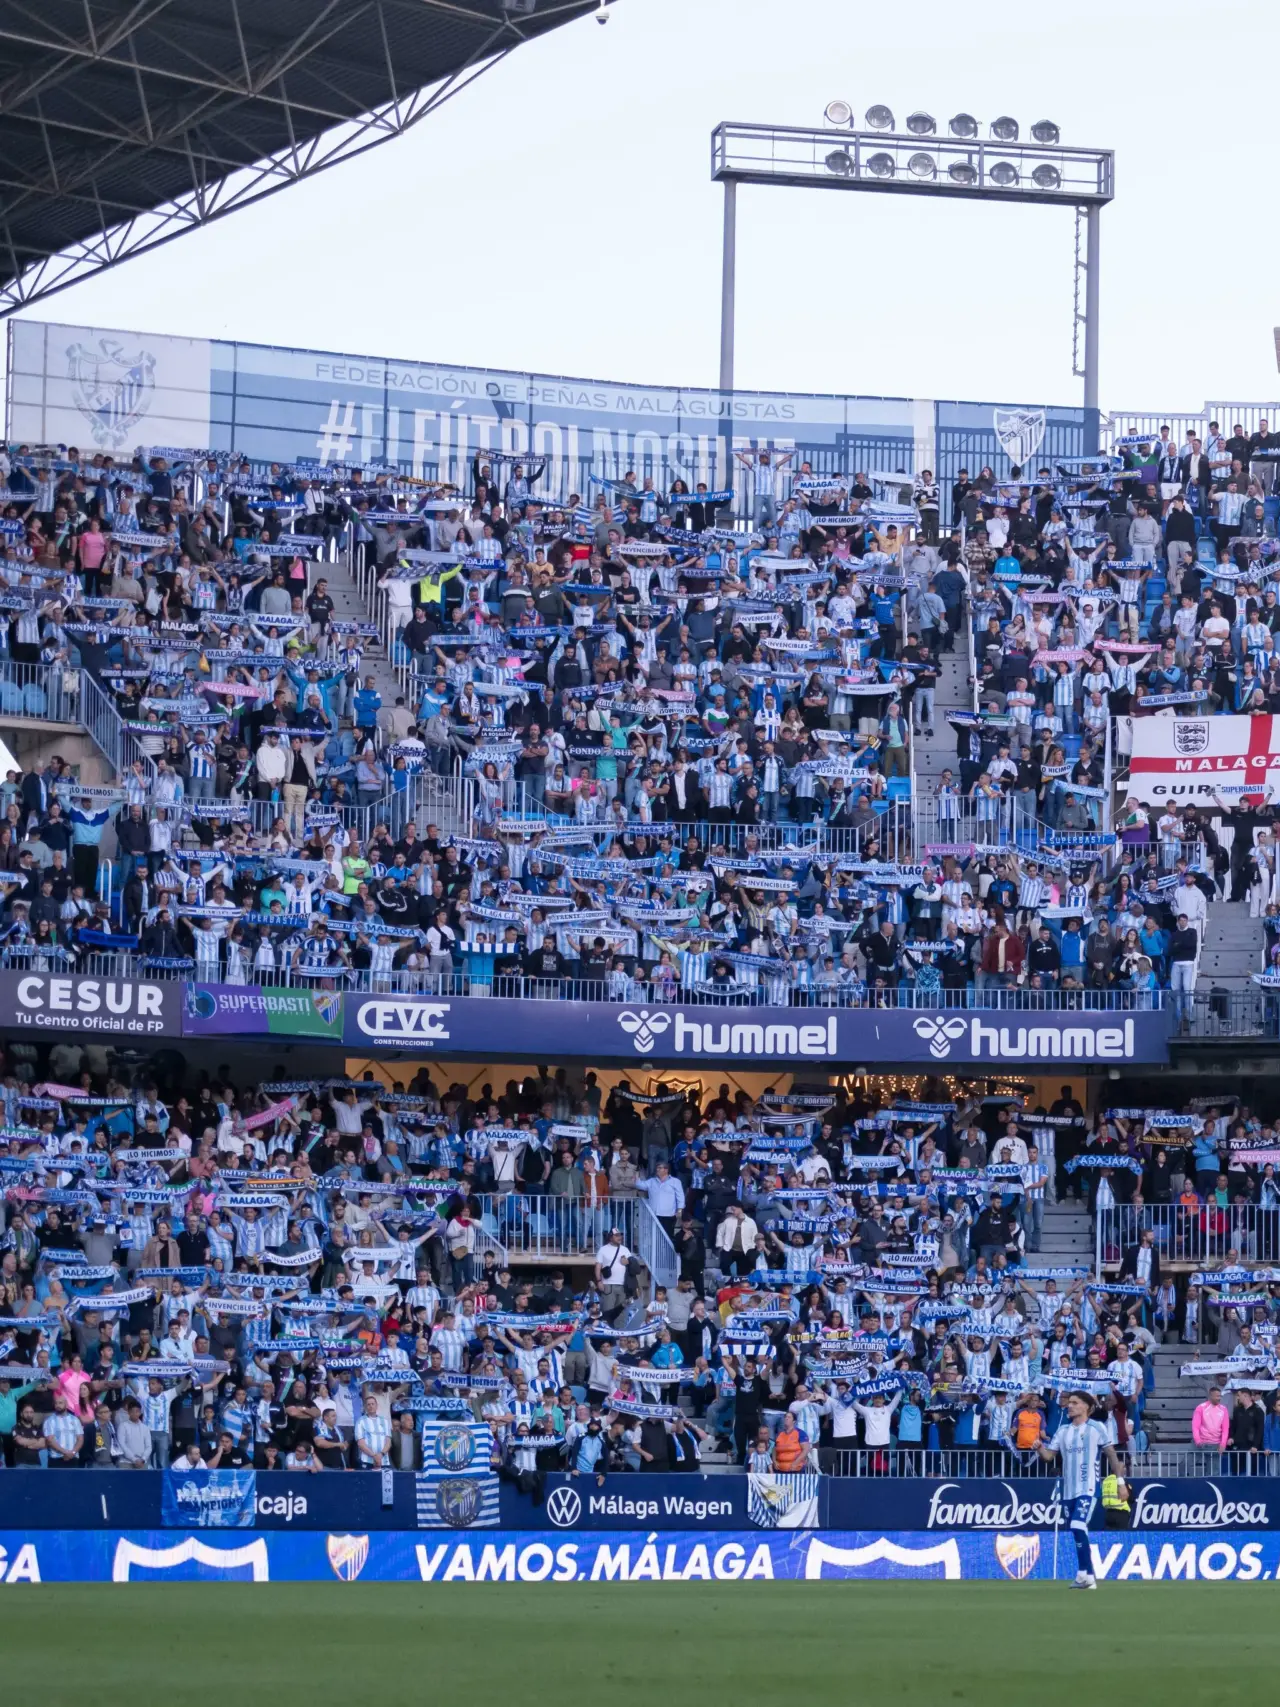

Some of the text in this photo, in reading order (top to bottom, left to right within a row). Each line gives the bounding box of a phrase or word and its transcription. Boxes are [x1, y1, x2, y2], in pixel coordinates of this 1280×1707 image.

[316, 362, 477, 397] FEDERACIÓN
[526, 384, 608, 410] PEÑAS
[616, 397, 796, 421] MALAGUISTAS
[1222, 785, 1263, 793] SUPERBASTI
[501, 822, 546, 830] INVENCIBLES
[17, 977, 163, 1016] CESUR
[219, 994, 310, 1011] SUPERBASTI
[16, 1012, 163, 1032] Tu Centro Oficial de FP
[373, 1038, 434, 1047] CONSTRUCCIONES
[674, 1012, 837, 1055] hummel
[971, 1019, 1134, 1057] hummel
[242, 1276, 294, 1286] MALAGA
[209, 1301, 256, 1312] INVENCIBLES
[631, 1370, 680, 1379] INVENCIBLES
[855, 1378, 900, 1396] MALAGA
[589, 1494, 732, 1519] Málaga Wagen
[927, 1482, 1066, 1528] famadesa
[1132, 1481, 1270, 1528] famadesa
[416, 1531, 775, 1581] VAMOS, MÁLAGA
[1091, 1542, 1271, 1581] VAMOS,
